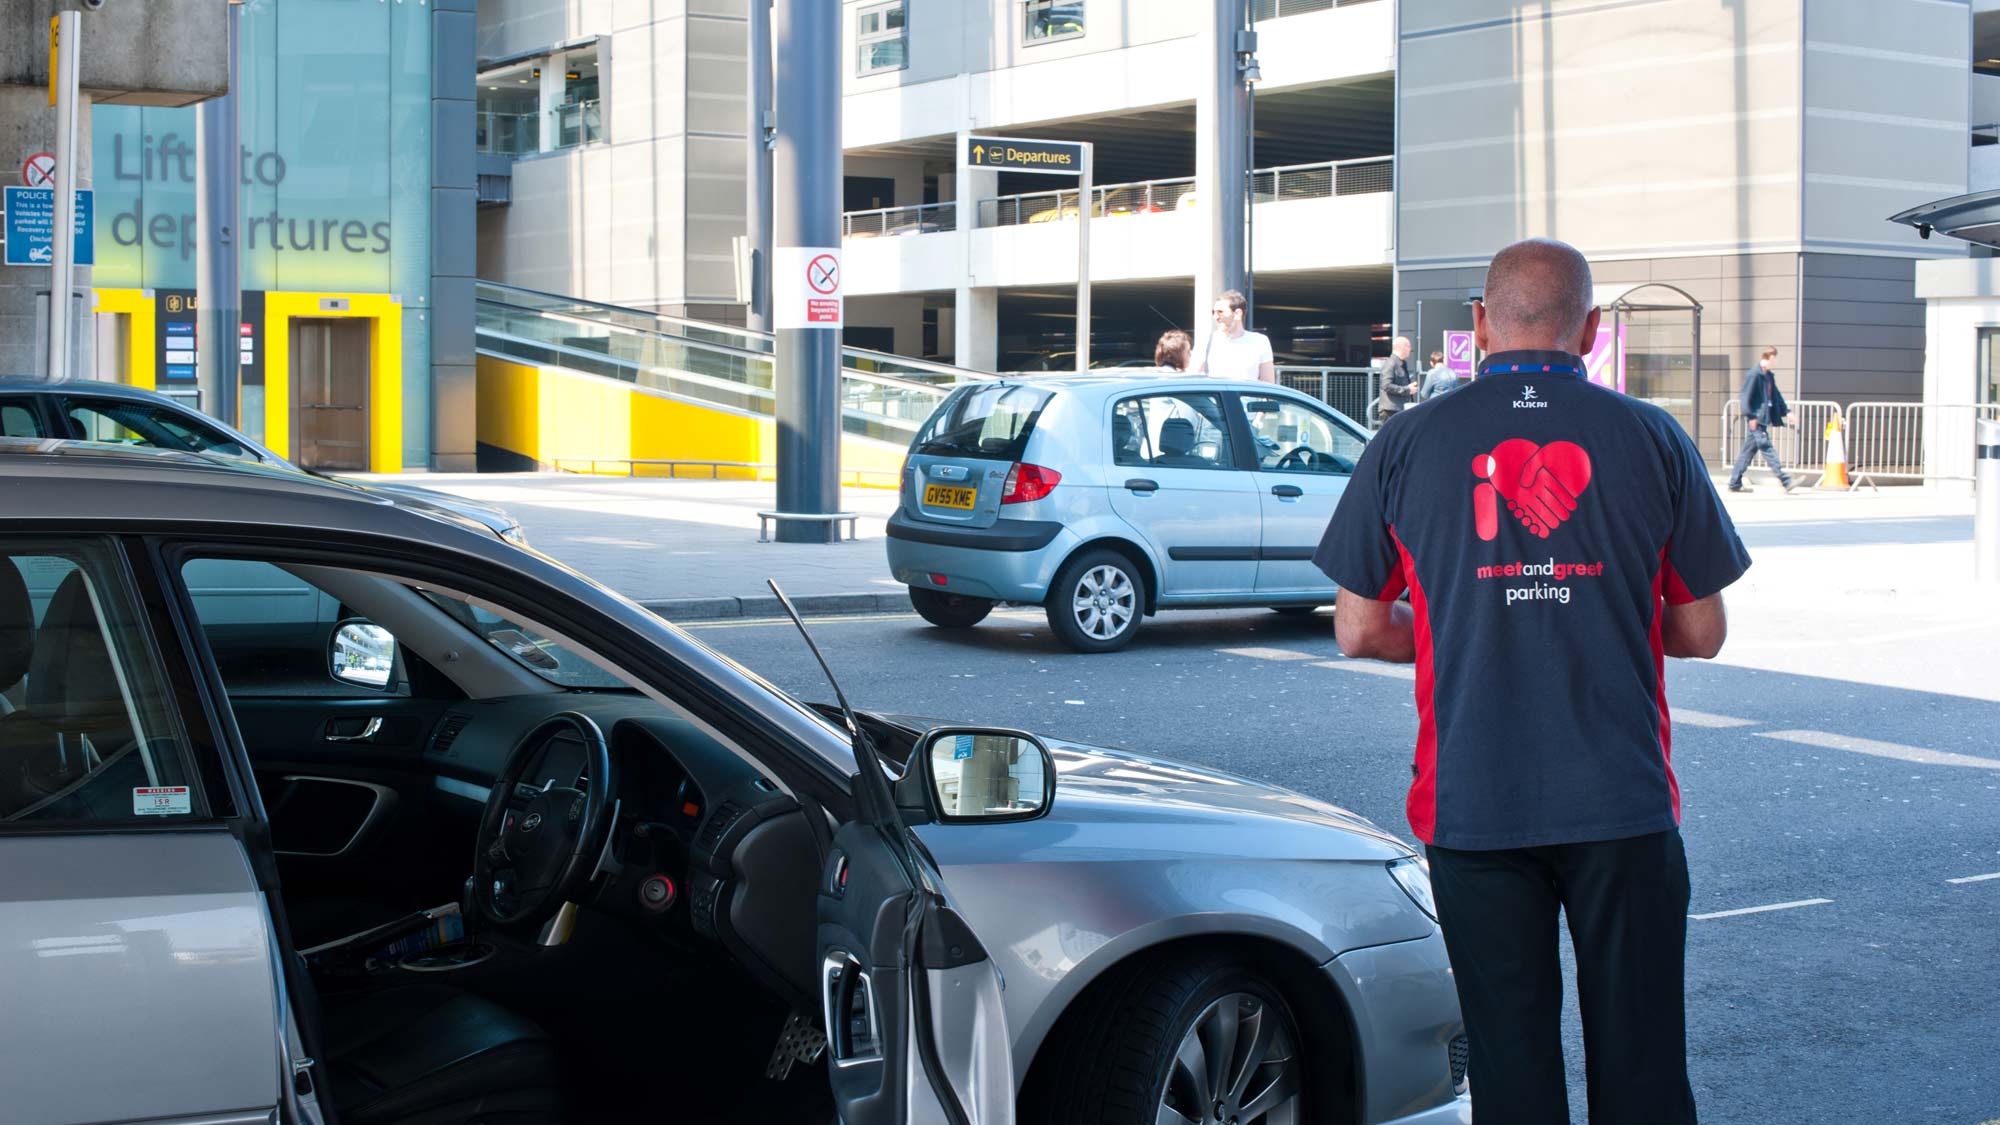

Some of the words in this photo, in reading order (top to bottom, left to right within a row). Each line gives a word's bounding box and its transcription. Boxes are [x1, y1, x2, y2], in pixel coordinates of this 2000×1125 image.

[114, 133, 196, 183] Lift
[240, 144, 287, 187] to
[1006, 148, 1071, 165] Departures
[16, 191, 48, 200] POLICE
[111, 198, 392, 261] deprtures
[1512, 400, 1548, 408] KUKRI
[927, 487, 952, 503] GV55
[953, 489, 973, 506] XME
[1476, 557, 1604, 580] meetandgreet
[1505, 581, 1571, 606] parking
